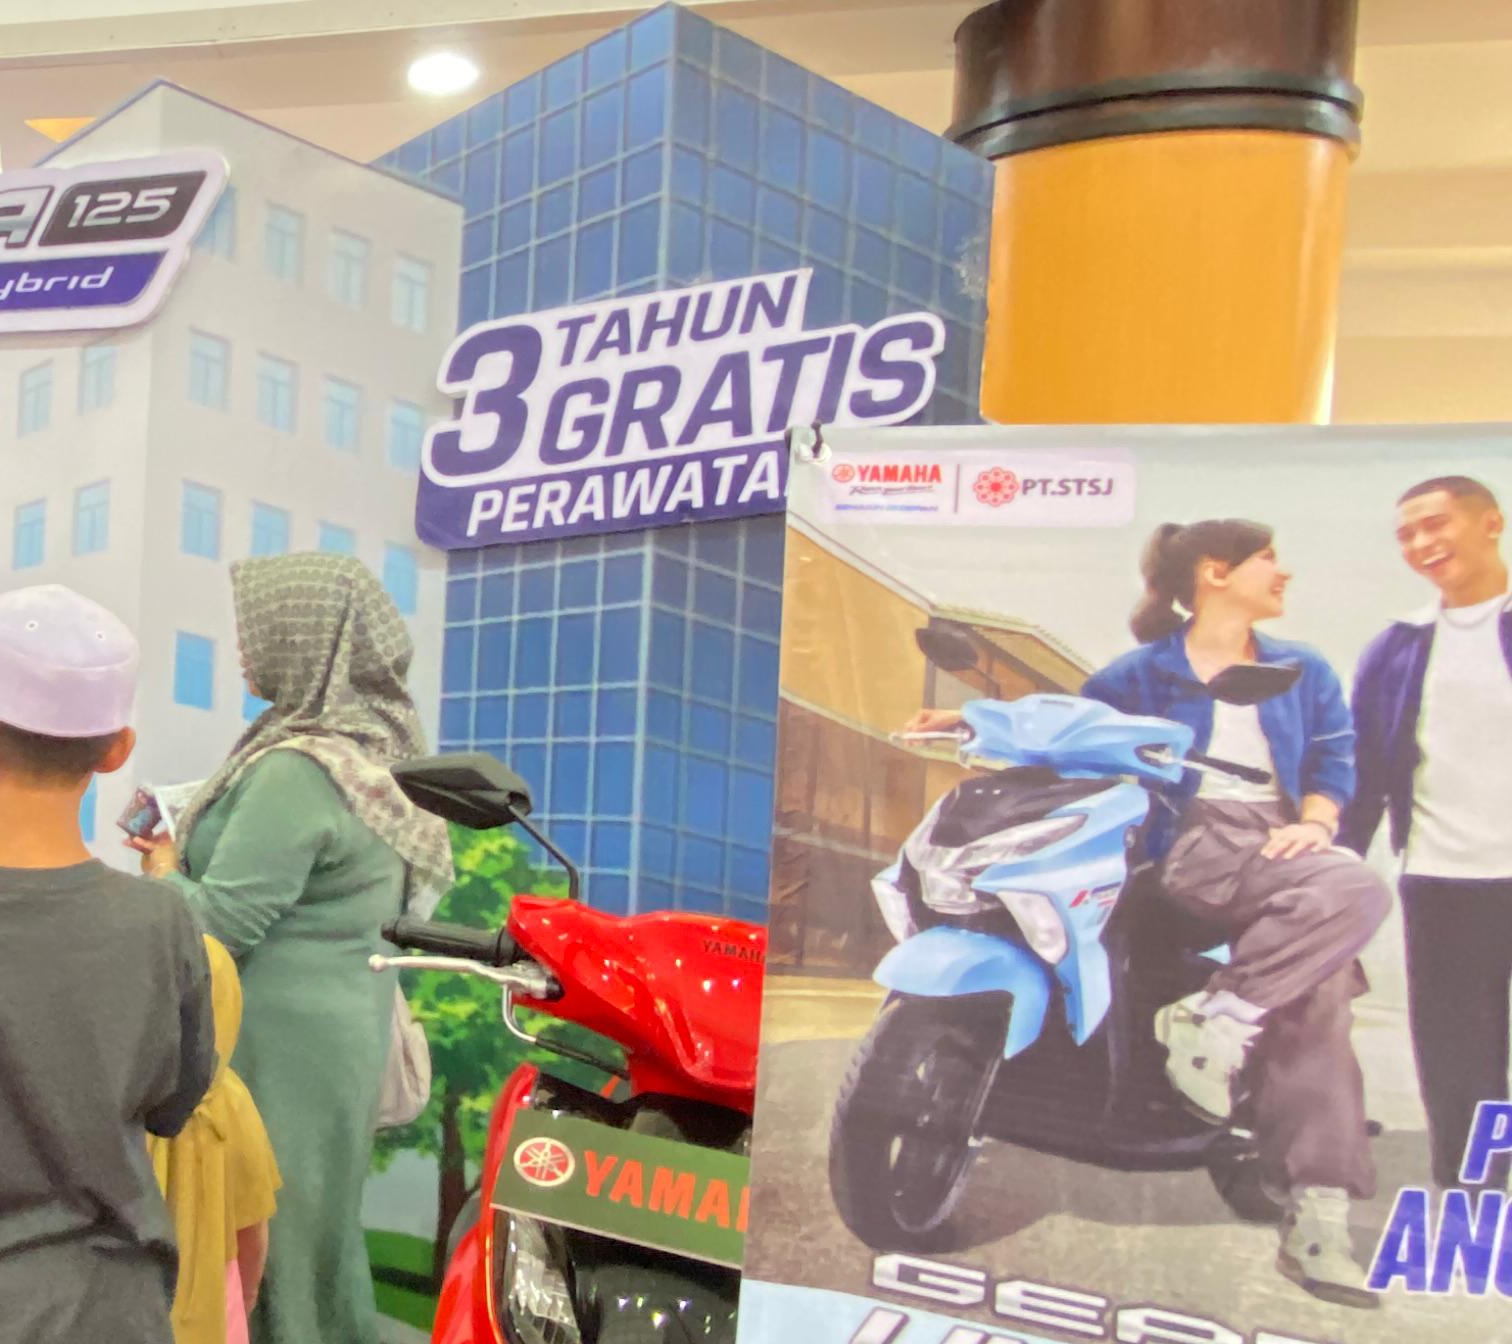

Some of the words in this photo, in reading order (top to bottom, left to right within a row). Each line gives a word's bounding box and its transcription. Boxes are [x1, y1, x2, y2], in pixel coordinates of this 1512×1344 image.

[69, 186, 178, 228] 125
[430, 324, 543, 477] 3
[557, 274, 798, 367] TAHUN
[539, 320, 936, 465] GRATIS
[465, 451, 789, 538] PERAWATA
[857, 464, 941, 483] YAMAHA
[1022, 477, 1114, 496] PT.STSJ
[703, 940, 765, 963] YAMAH
[1365, 1187, 1512, 1300] AN
